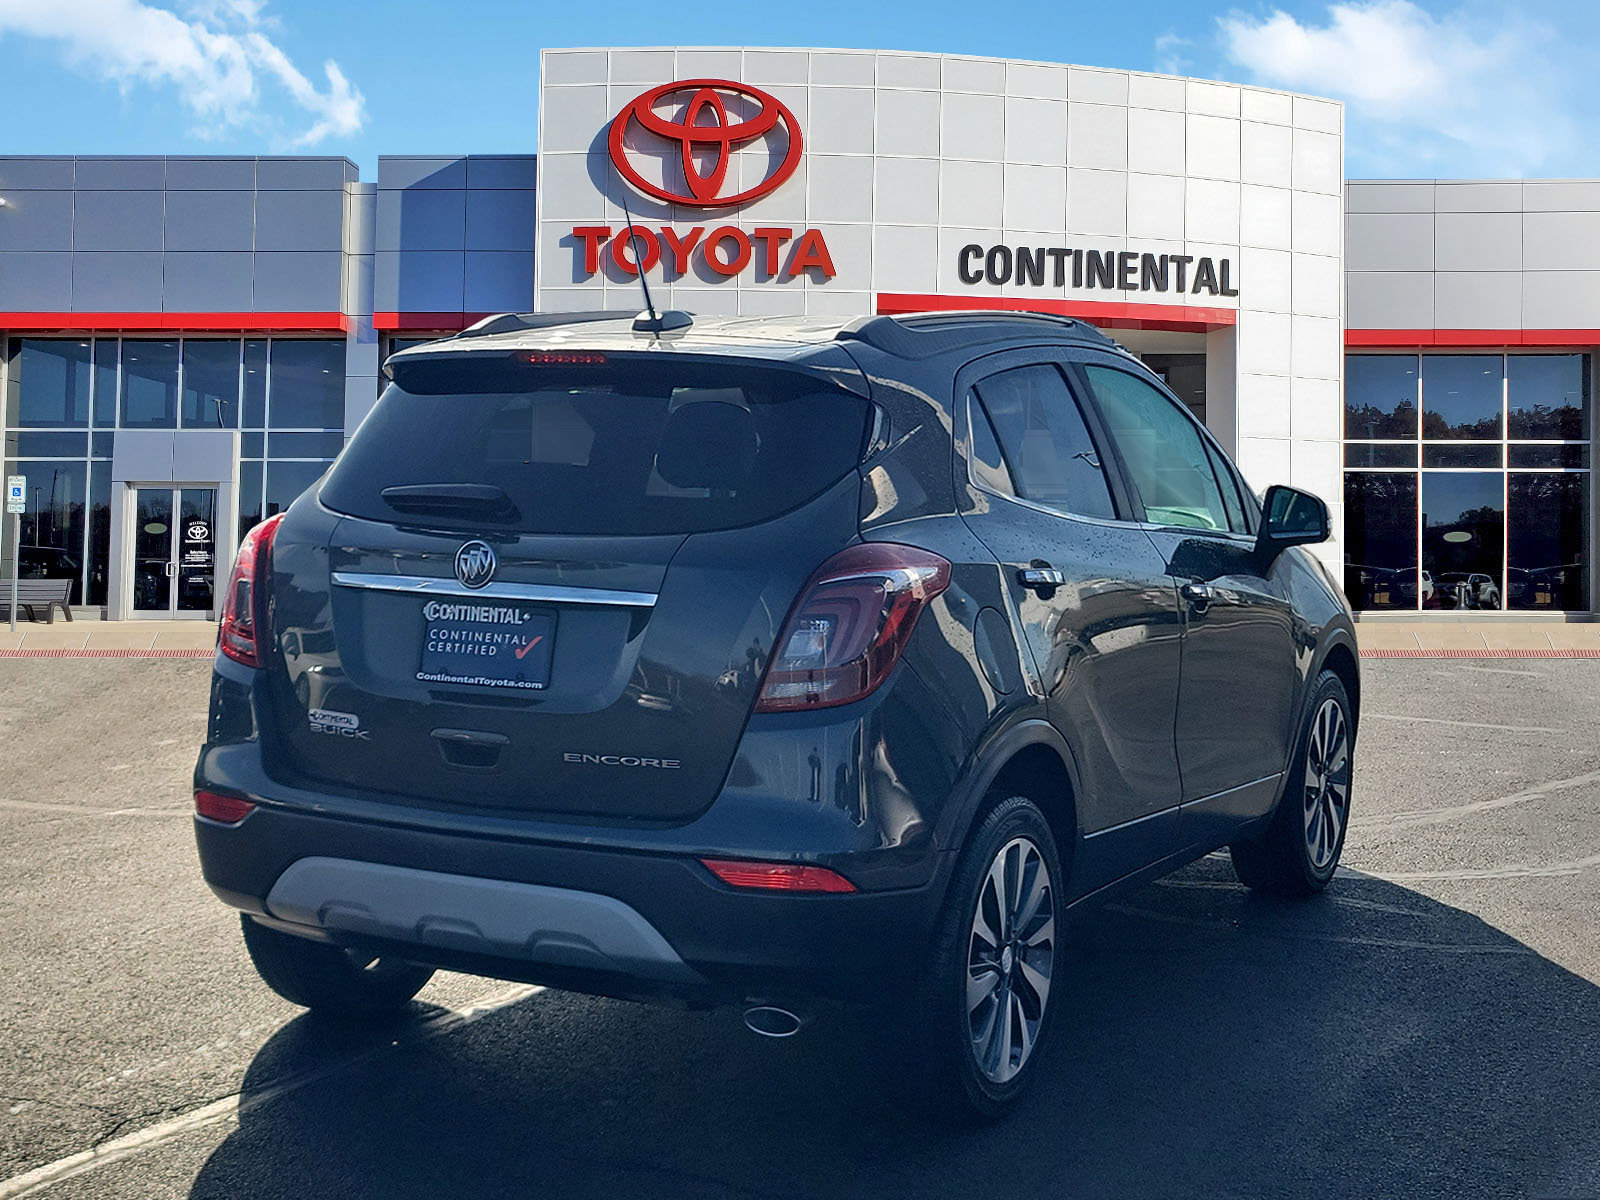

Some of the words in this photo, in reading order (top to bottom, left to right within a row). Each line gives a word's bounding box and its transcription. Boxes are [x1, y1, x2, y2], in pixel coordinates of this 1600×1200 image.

[572, 225, 837, 276] TOYOTA
[958, 244, 1239, 296] CONTINENTAL
[423, 600, 524, 625] CONTINENTAL
[430, 629, 528, 646] CONTINENTAL
[428, 641, 497, 656] CERTIFIED
[416, 672, 543, 689] ContinentalToyota.com
[309, 722, 372, 741] BUICK
[563, 752, 681, 769] ENCORE
